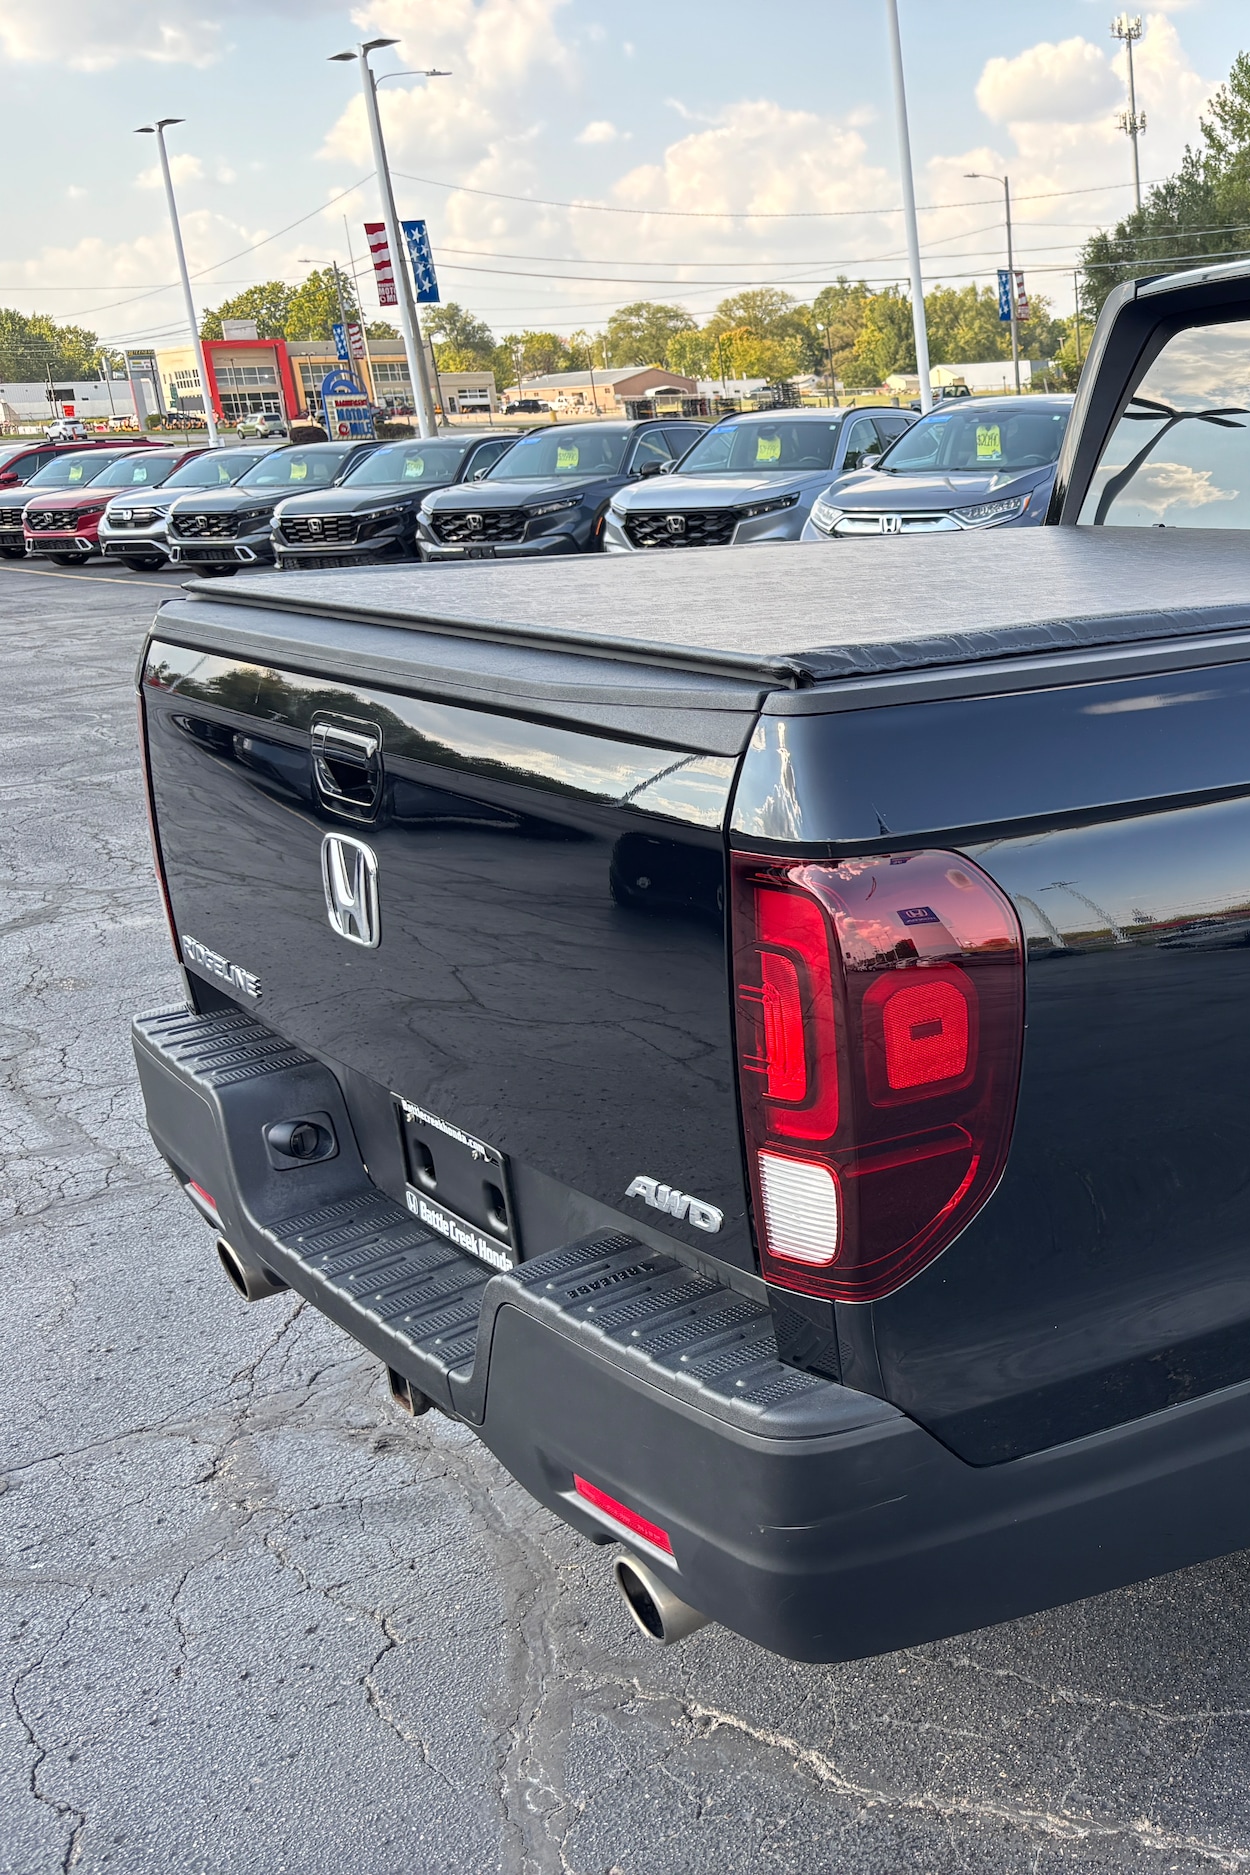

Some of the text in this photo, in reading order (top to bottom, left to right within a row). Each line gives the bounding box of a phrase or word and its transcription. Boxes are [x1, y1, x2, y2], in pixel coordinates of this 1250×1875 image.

[182, 934, 263, 999] RIDGELINE
[419, 1200, 514, 1272] Battle Creek Honda
[624, 1175, 725, 1234] AWD
